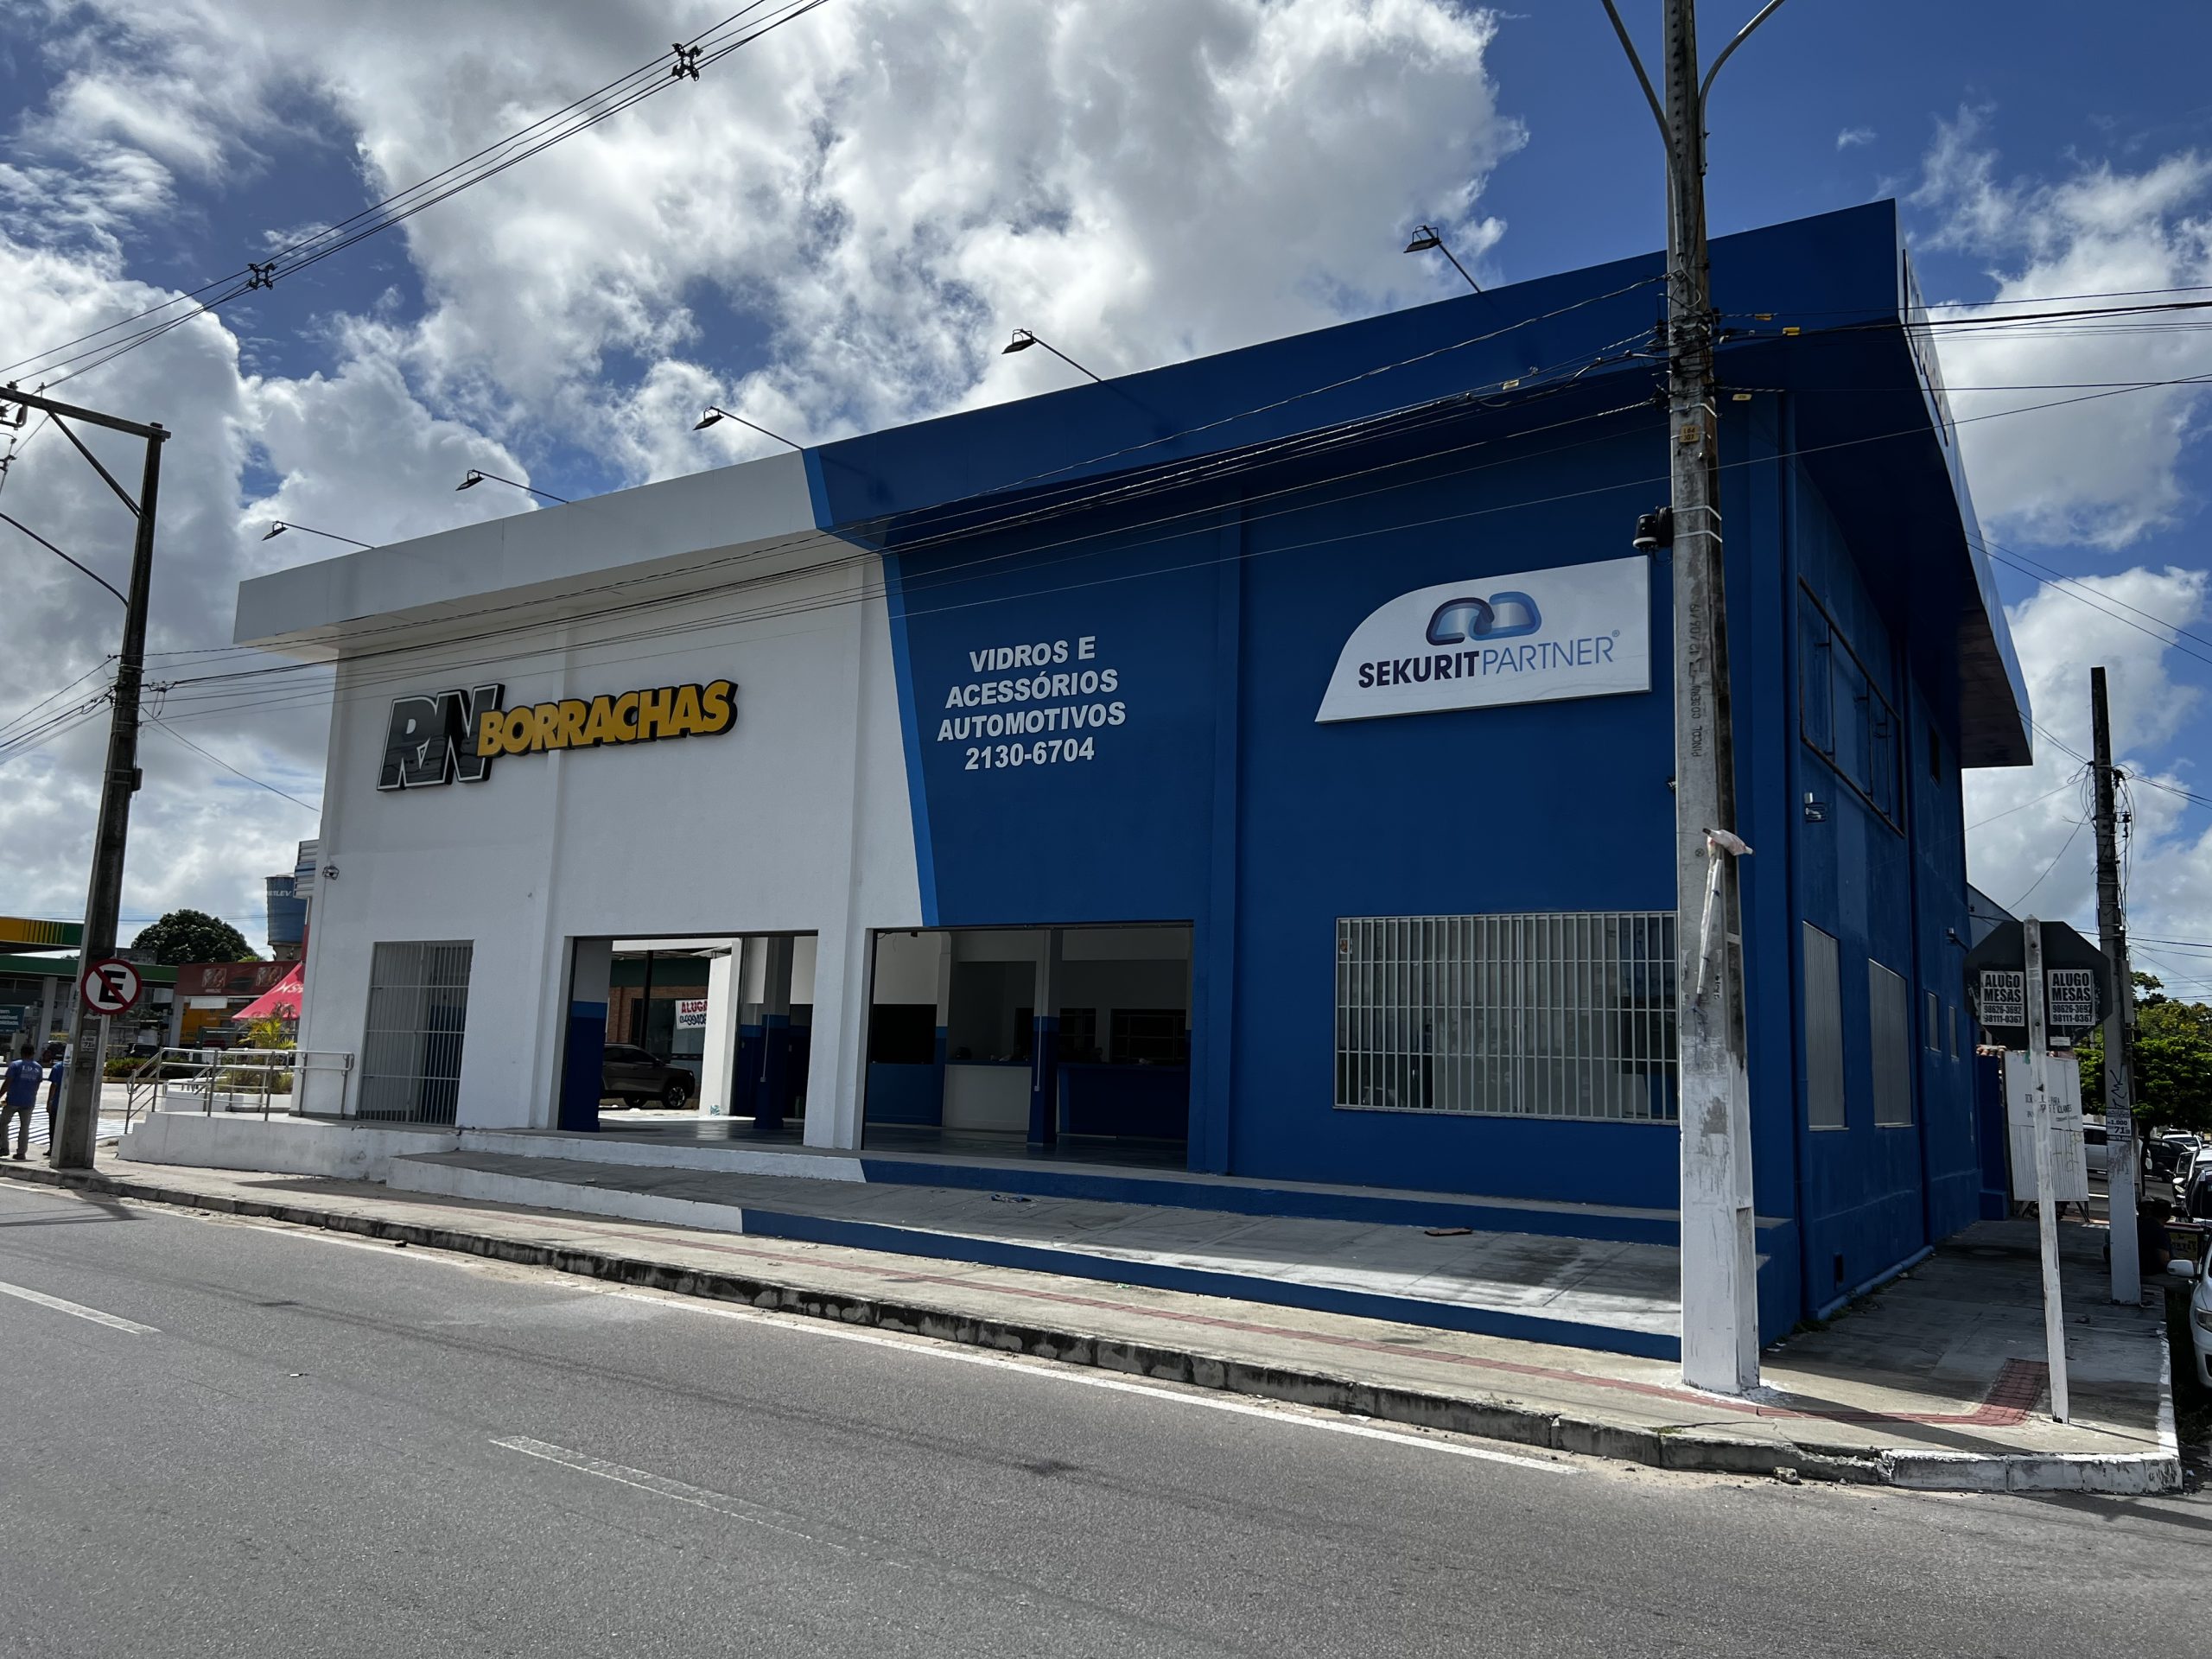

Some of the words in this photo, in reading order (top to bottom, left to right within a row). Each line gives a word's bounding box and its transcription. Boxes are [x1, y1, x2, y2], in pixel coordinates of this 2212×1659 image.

[969, 639, 1069, 673] VIDROS
[1077, 635, 1096, 660] E
[944, 668, 1118, 709] ACESSÓRIOS
[377, 683, 505, 792] RN
[476, 679, 739, 759] BORRACHAS
[937, 701, 1127, 742] AUTOMOTIVOS
[964, 736, 1096, 771] 2130-6704
[99, 969, 127, 1004] E
[1984, 988, 2021, 1002] MESAS
[1985, 974, 2020, 988] ALUGO
[2052, 972, 2089, 987] ALUGO
[2052, 987, 2091, 1001] MESAS
[2052, 1014, 2092, 1023] 98111-0367
